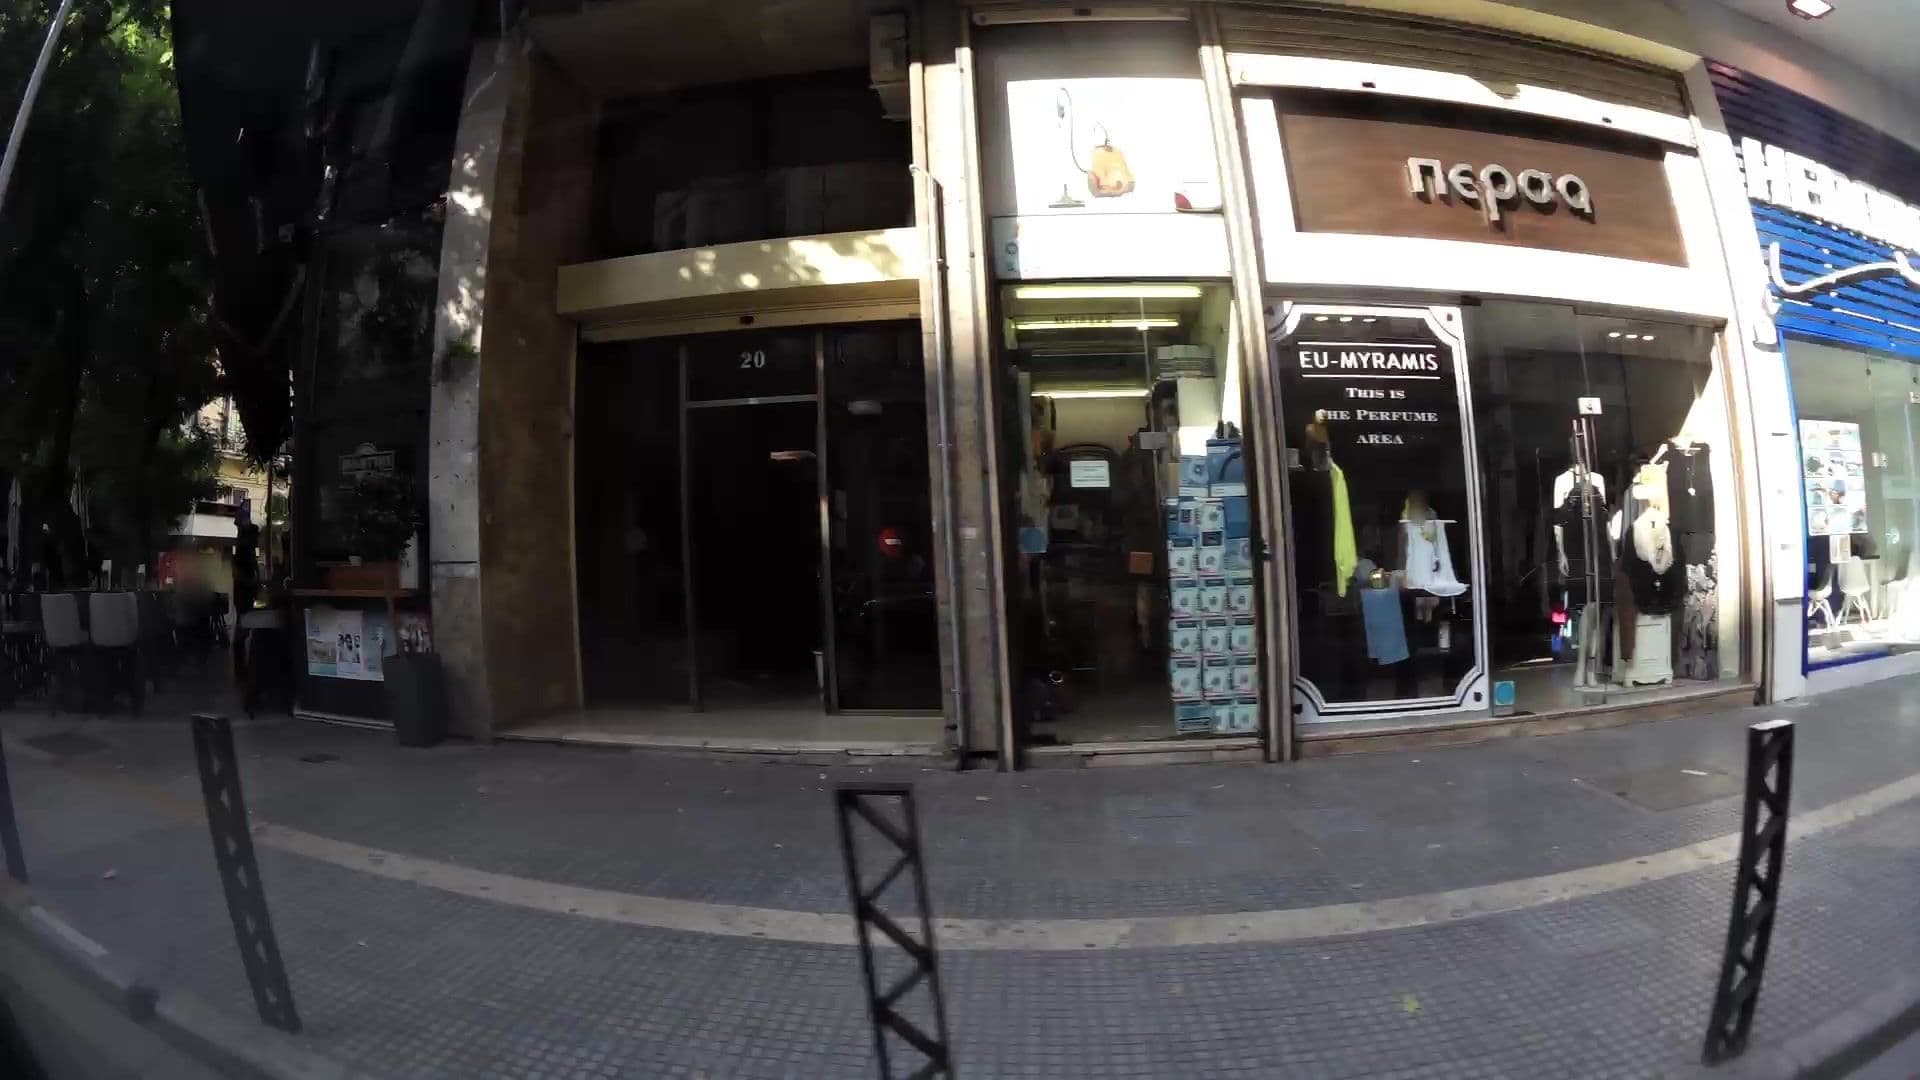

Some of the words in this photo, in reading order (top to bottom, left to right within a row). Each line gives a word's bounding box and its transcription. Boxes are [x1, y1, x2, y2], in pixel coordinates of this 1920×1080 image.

[740, 350, 766, 369] 20
[1298, 351, 1439, 371] EU-MYRAMIS
[1356, 409, 1438, 422] PERFUME
[1356, 433, 1404, 445] AREA
